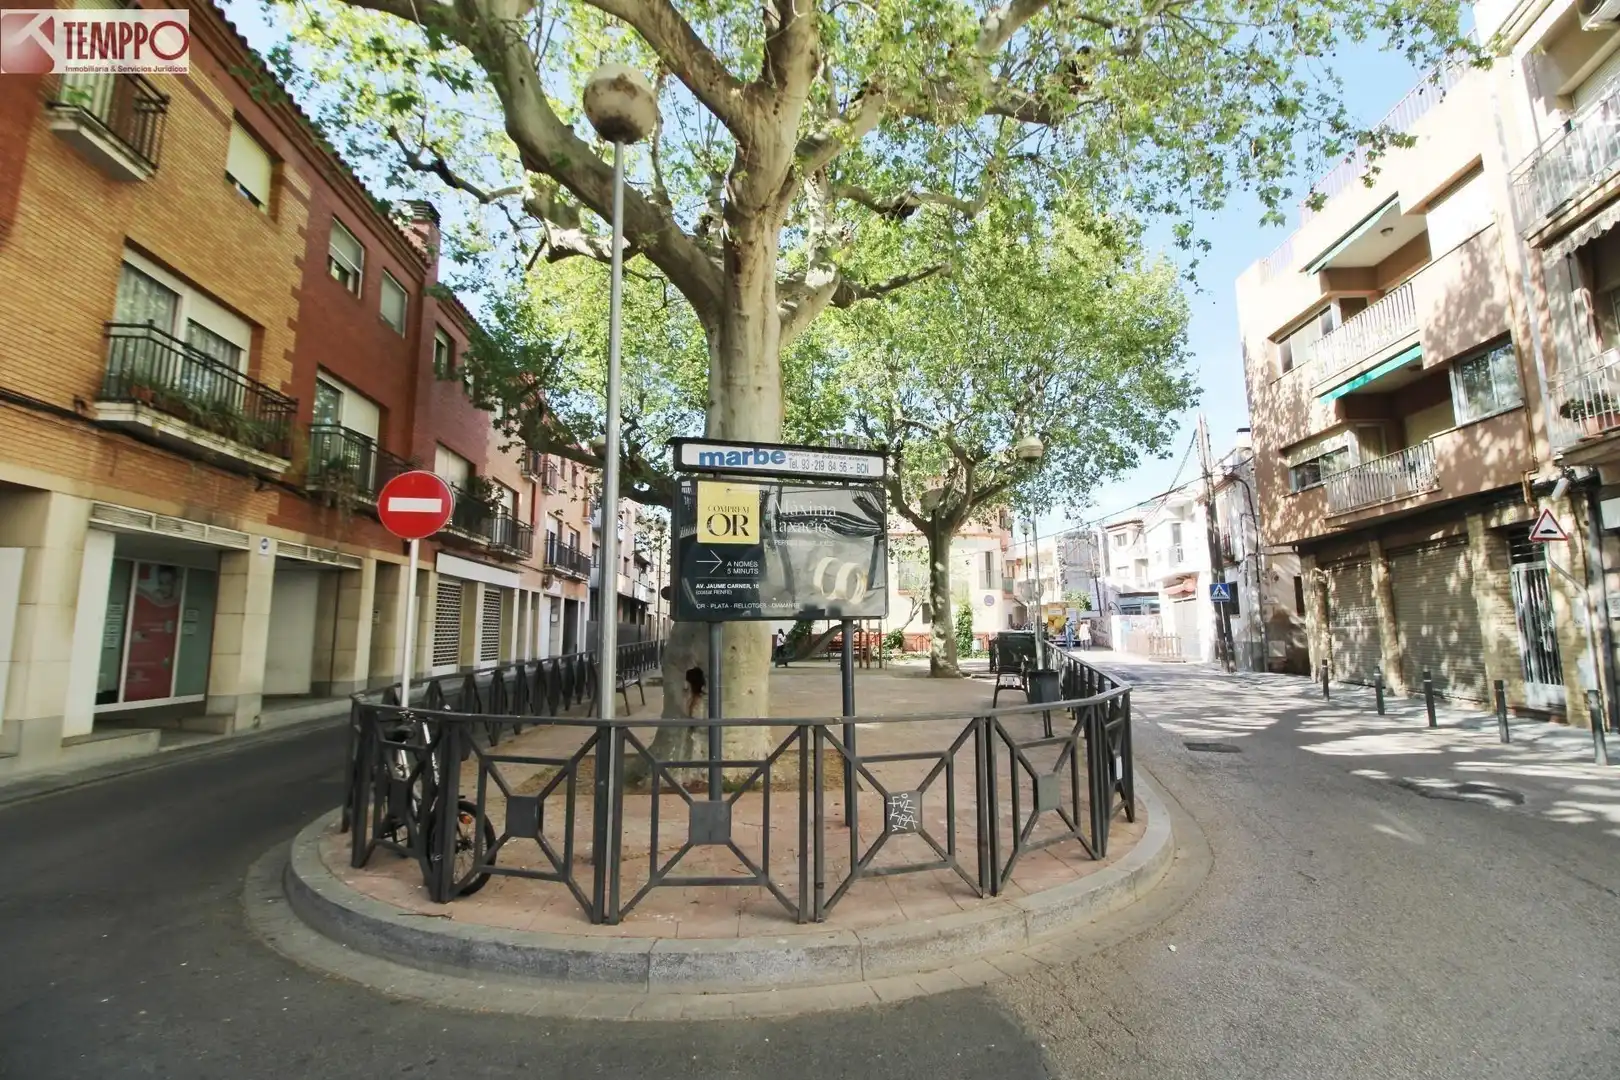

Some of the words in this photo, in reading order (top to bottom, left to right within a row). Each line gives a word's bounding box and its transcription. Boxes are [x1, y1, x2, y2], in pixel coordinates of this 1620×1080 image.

[698, 448, 787, 467] marbe
[802, 459, 809, 470] 93
[856, 463, 869, 474] BCN
[707, 513, 750, 537] OR
